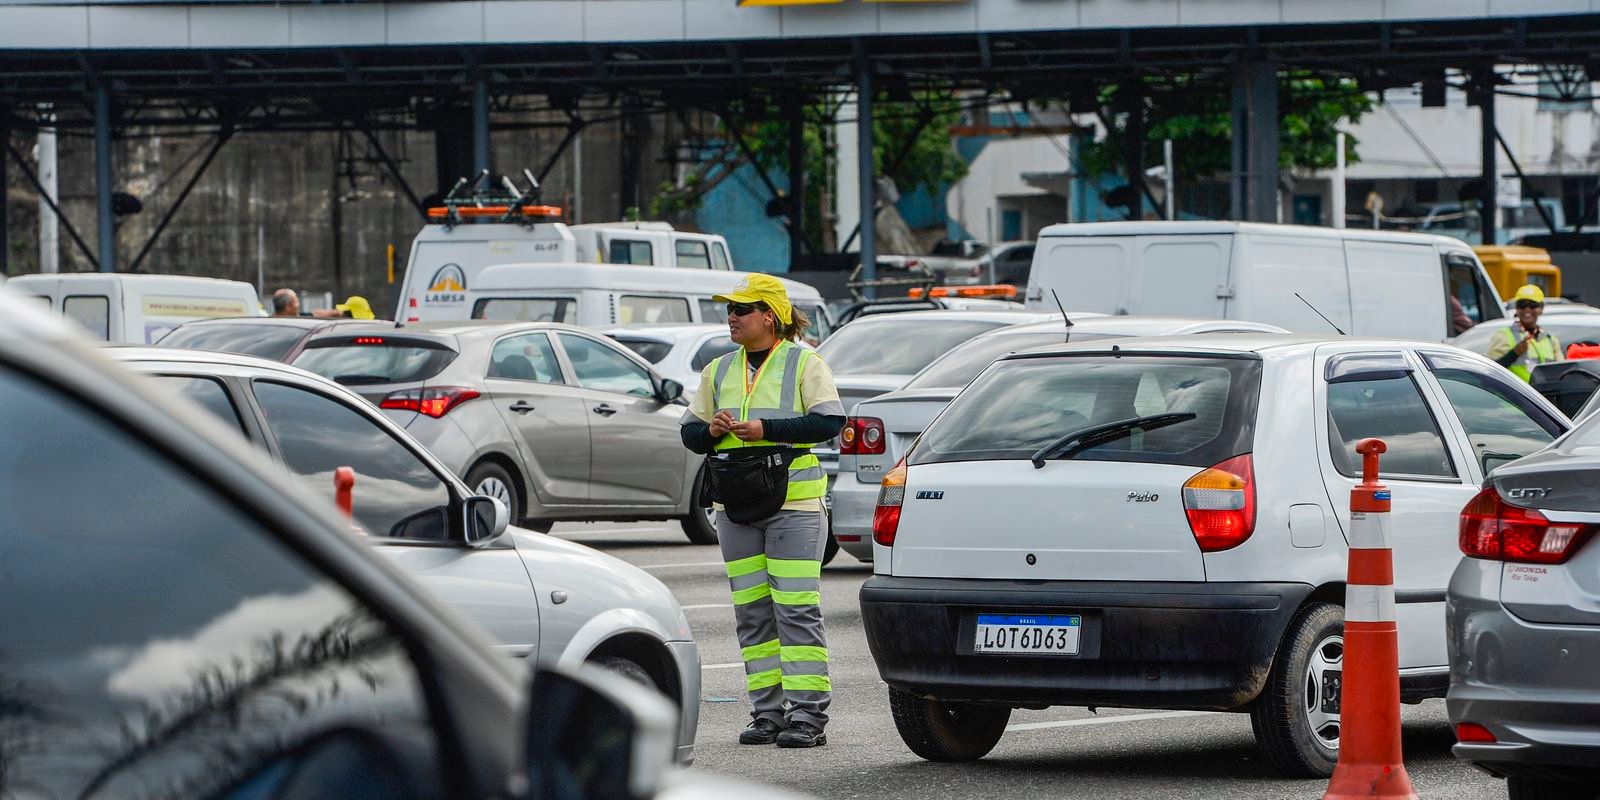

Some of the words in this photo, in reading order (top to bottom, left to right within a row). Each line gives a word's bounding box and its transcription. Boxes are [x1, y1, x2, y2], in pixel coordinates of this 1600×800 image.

[425, 294, 465, 303] LAMSA
[917, 491, 943, 499] FIAT
[1508, 487, 1553, 498] CITY
[984, 627, 1067, 649] LOT6D63
